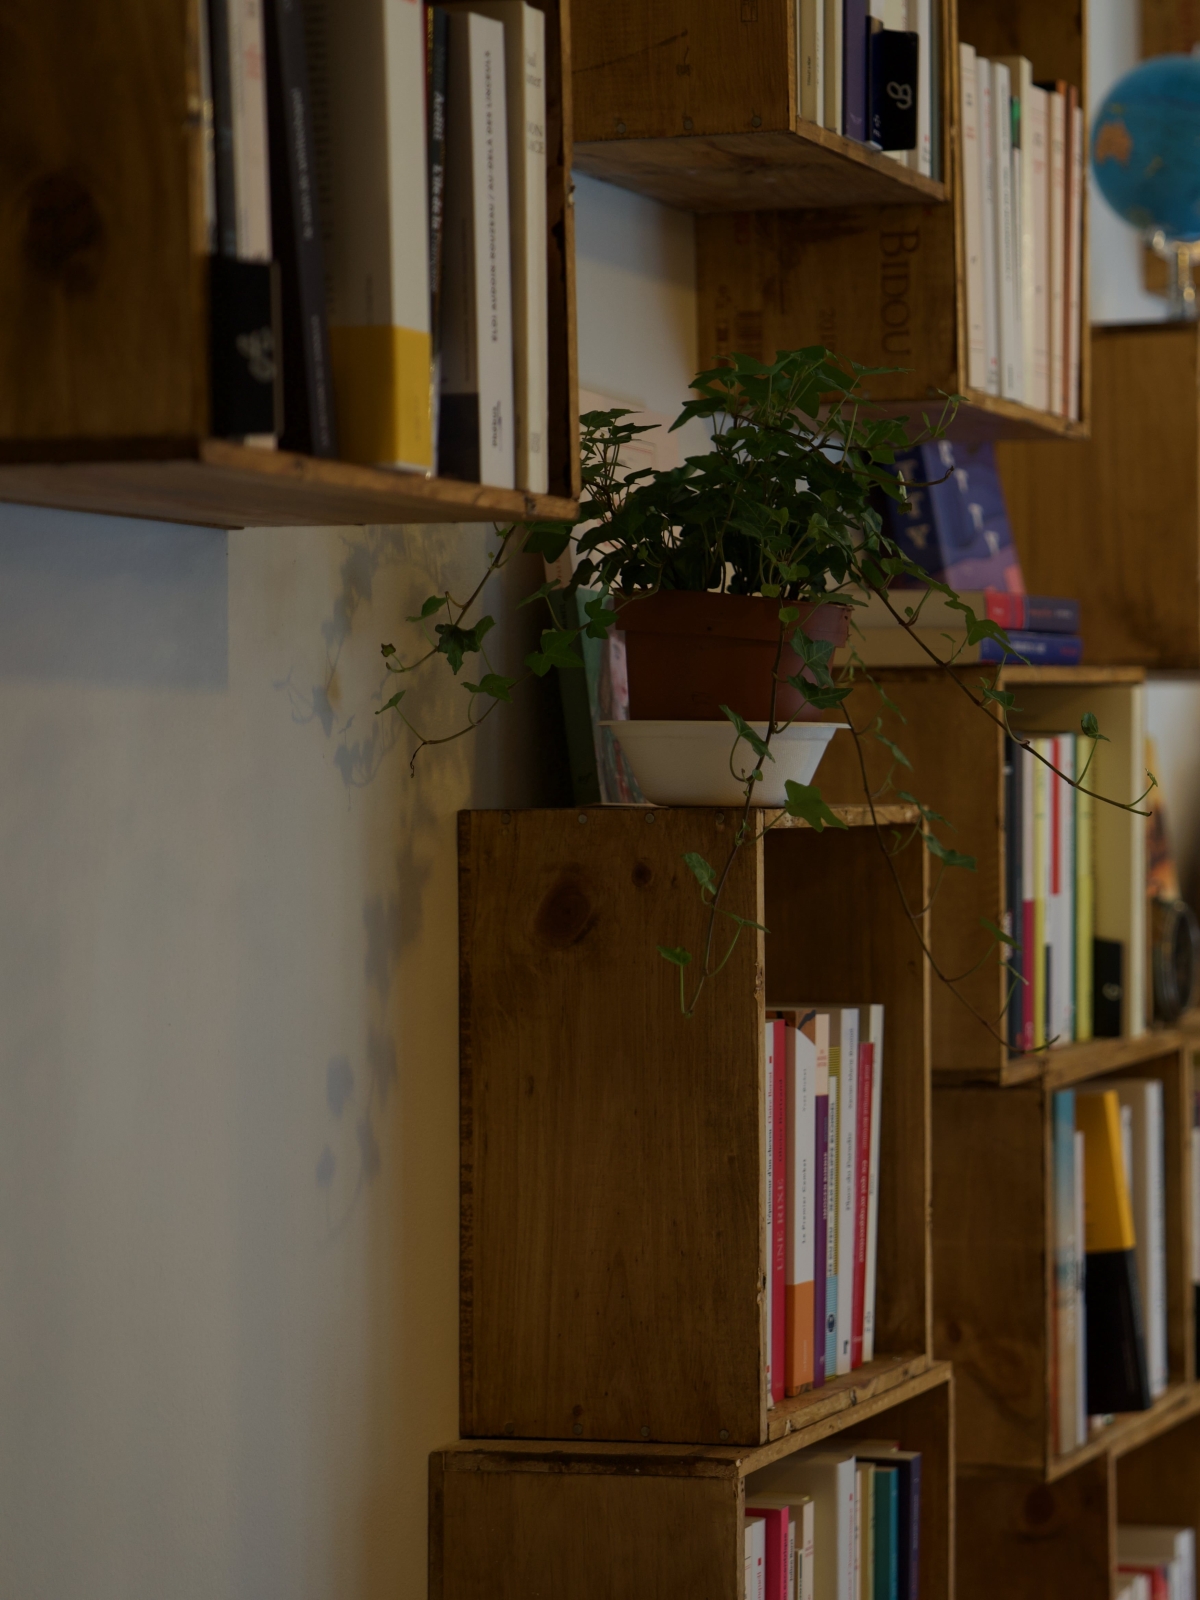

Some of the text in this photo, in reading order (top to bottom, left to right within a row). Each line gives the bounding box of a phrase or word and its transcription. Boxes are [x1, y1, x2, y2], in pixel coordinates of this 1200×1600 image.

[484, 50, 492, 108] LINCEULS
[433, 90, 445, 141] Arditi
[485, 111, 493, 135] DES
[485, 138, 494, 191] AU-DELÀ
[489, 203, 498, 310] AUDOIN-ROUZEAU
[879, 226, 920, 356] BIDOU
[776, 1178, 784, 1270] UNE RIXE
